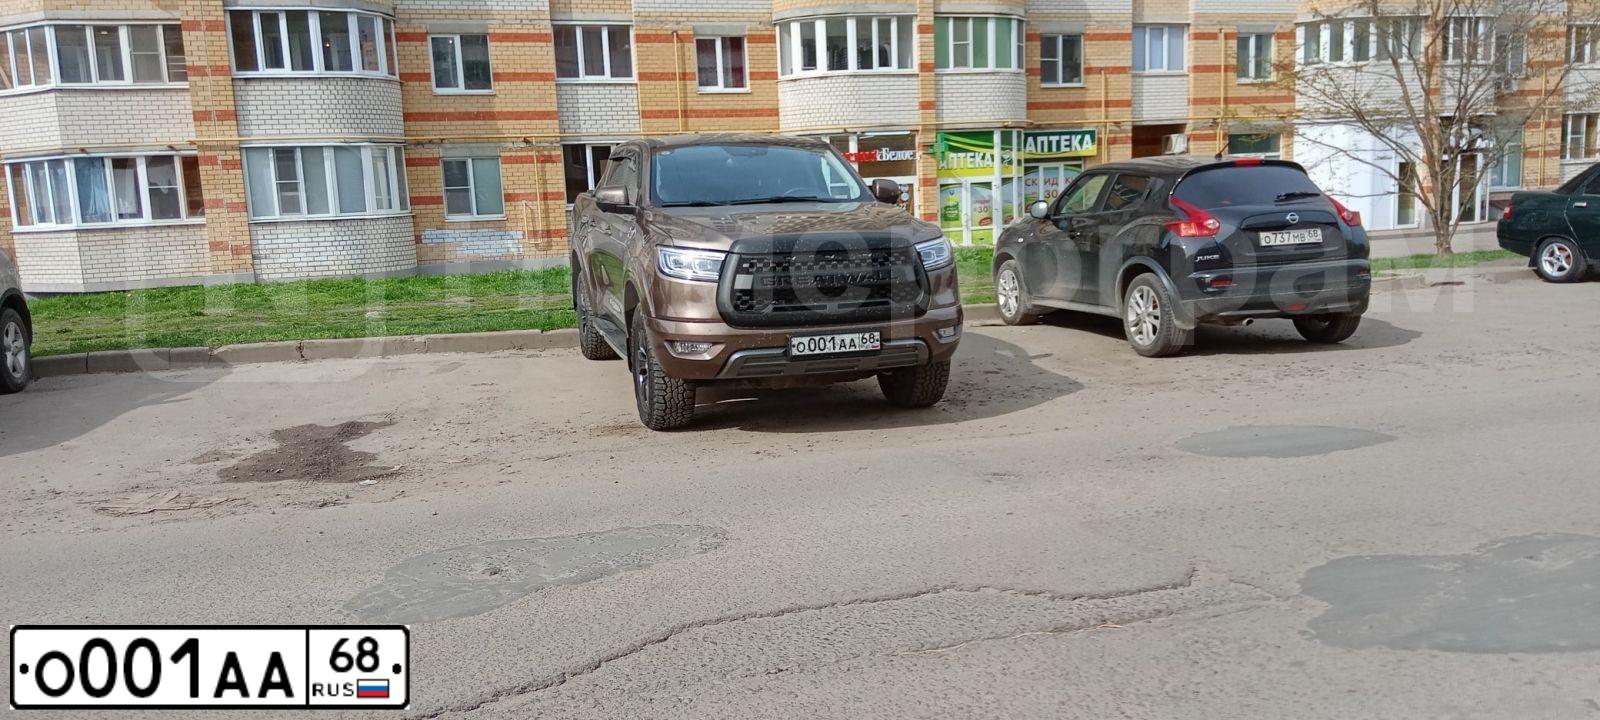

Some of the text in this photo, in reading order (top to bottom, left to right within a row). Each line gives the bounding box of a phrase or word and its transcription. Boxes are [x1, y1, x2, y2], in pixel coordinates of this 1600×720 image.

[1025, 134, 1093, 153] АПТЕКА
[1194, 254, 1220, 262] JUKE
[861, 333, 876, 345] 68
